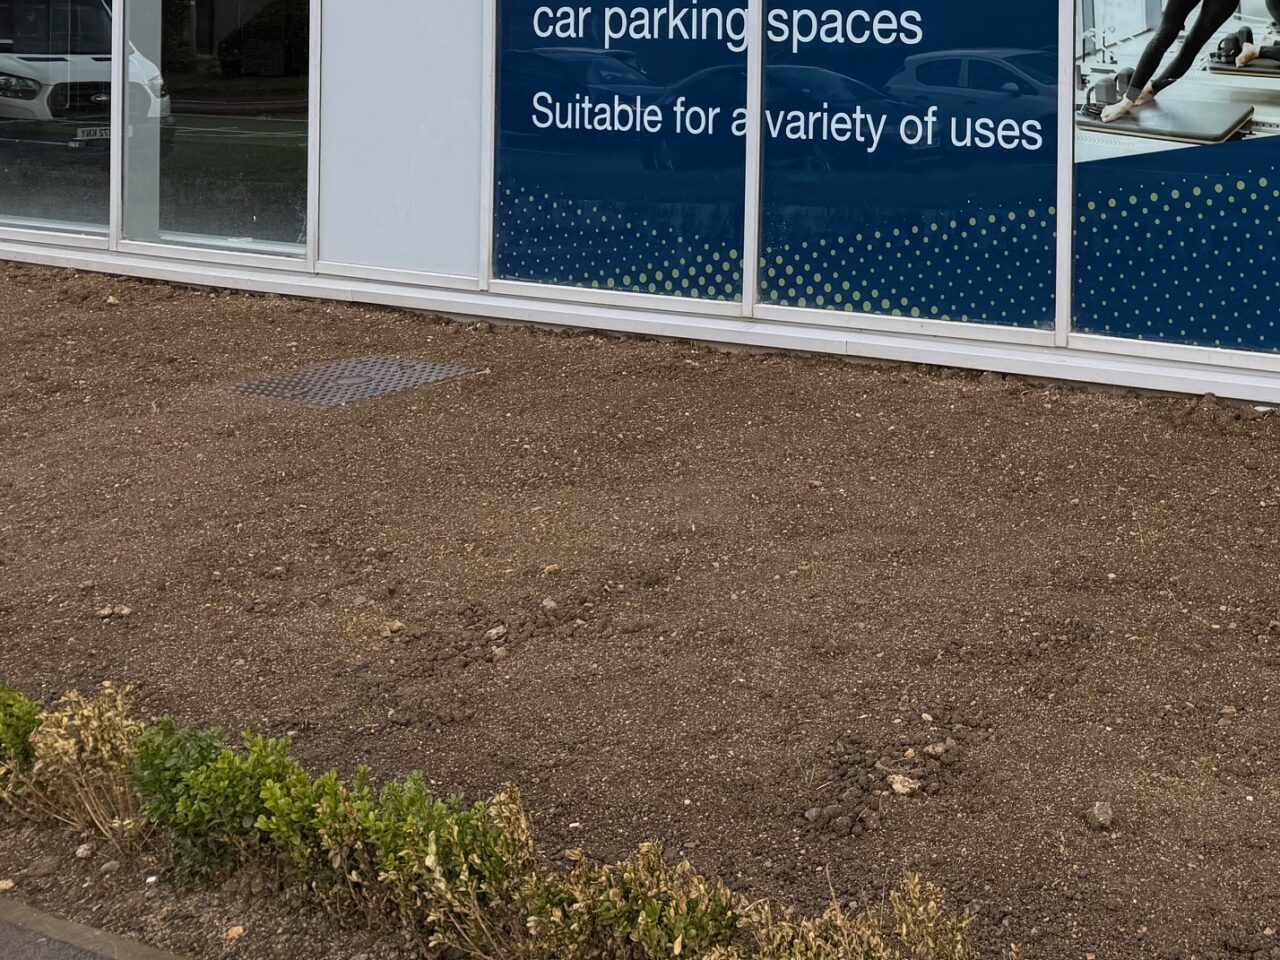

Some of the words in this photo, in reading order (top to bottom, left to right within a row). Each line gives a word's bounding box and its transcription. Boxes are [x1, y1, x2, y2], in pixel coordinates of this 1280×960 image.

[533, 6, 593, 39] car
[767, 8, 923, 54] spaces
[532, 91, 664, 133] Suitable
[673, 96, 721, 135] for
[731, 107, 748, 137] a
[765, 102, 888, 154] variety
[899, 105, 938, 145] of
[950, 117, 1043, 151] uses
